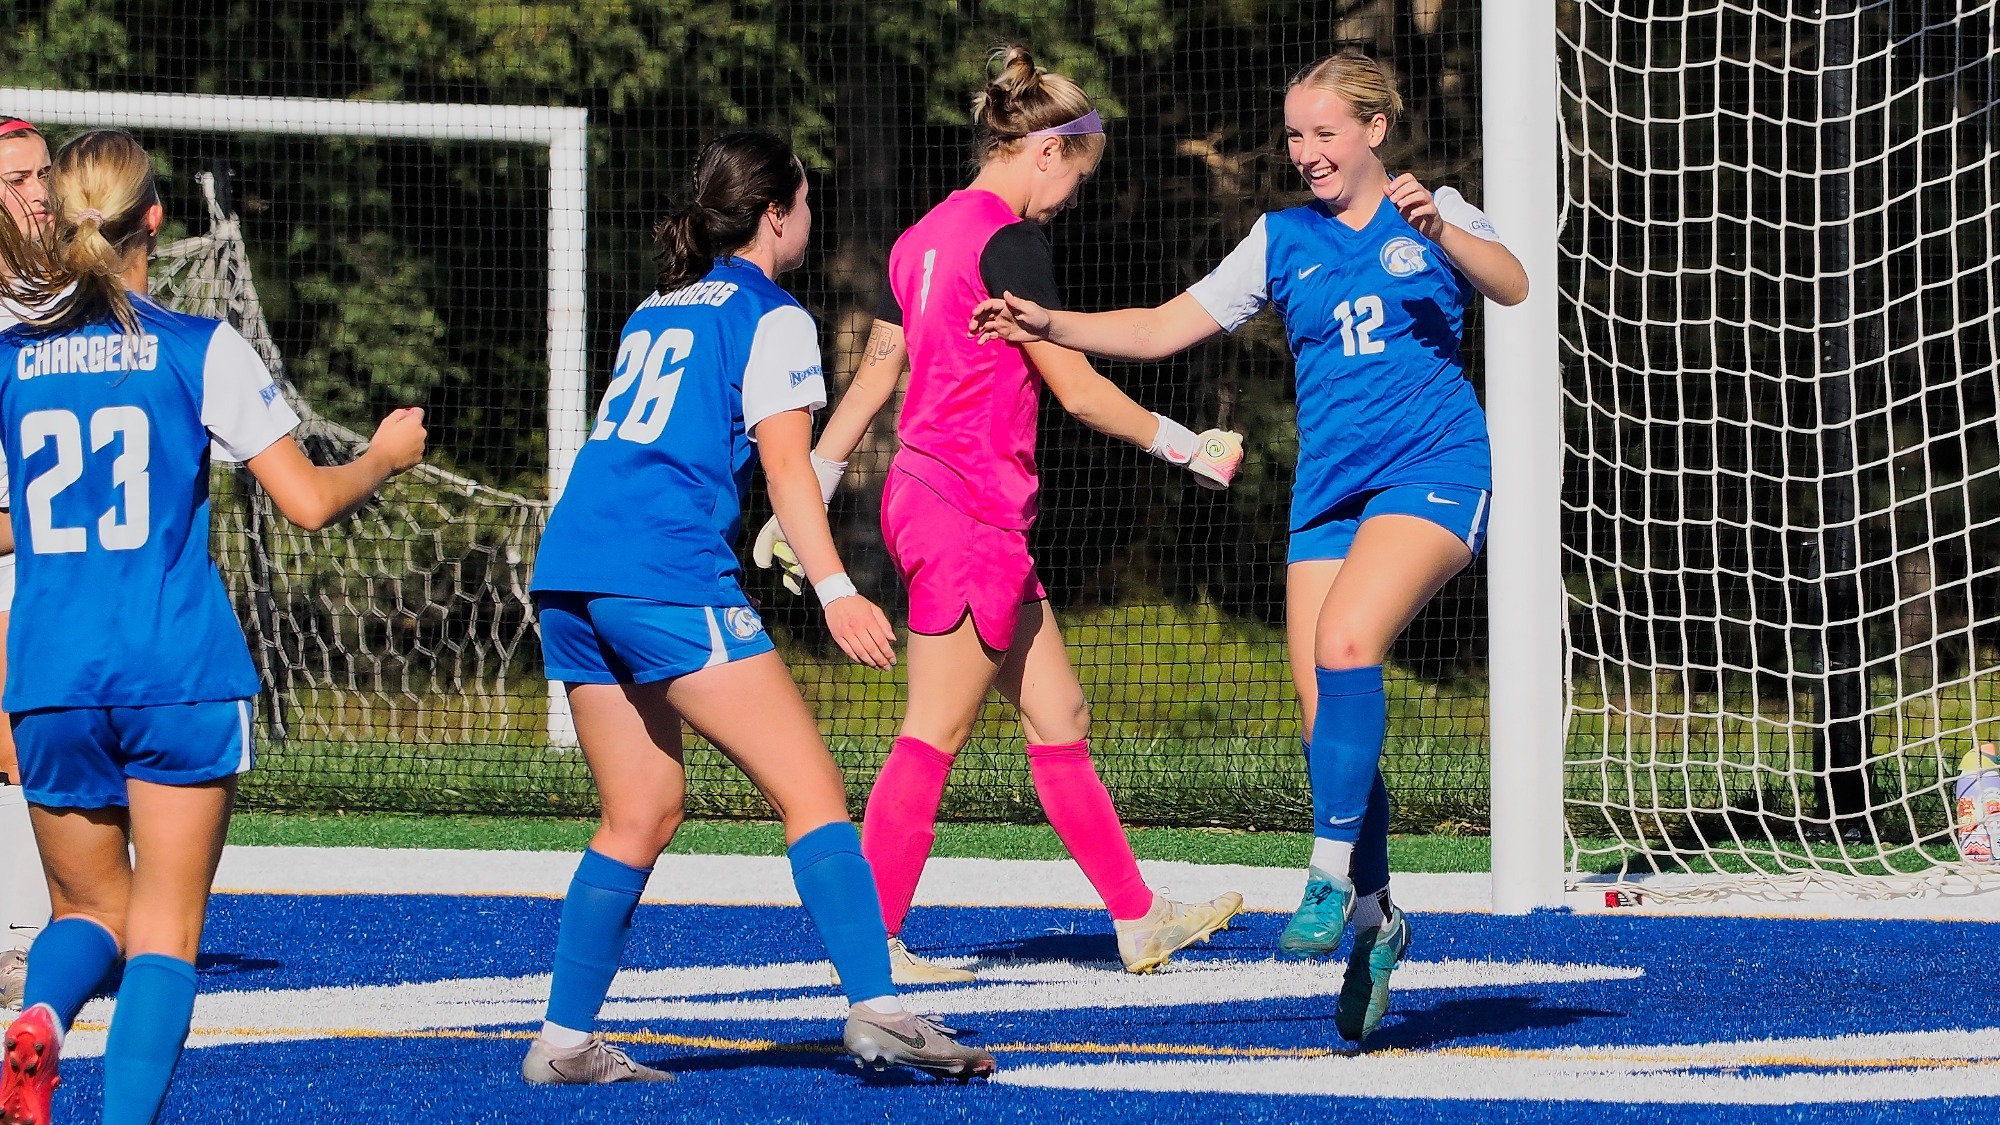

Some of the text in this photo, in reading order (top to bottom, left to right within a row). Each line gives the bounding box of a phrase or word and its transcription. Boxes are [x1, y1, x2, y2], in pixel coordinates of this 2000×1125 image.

[920, 248, 937, 317] 1
[17, 334, 159, 381] CHARGERS
[1333, 295, 1386, 357] 12
[589, 328, 694, 444] 26
[20, 405, 150, 555] 23
